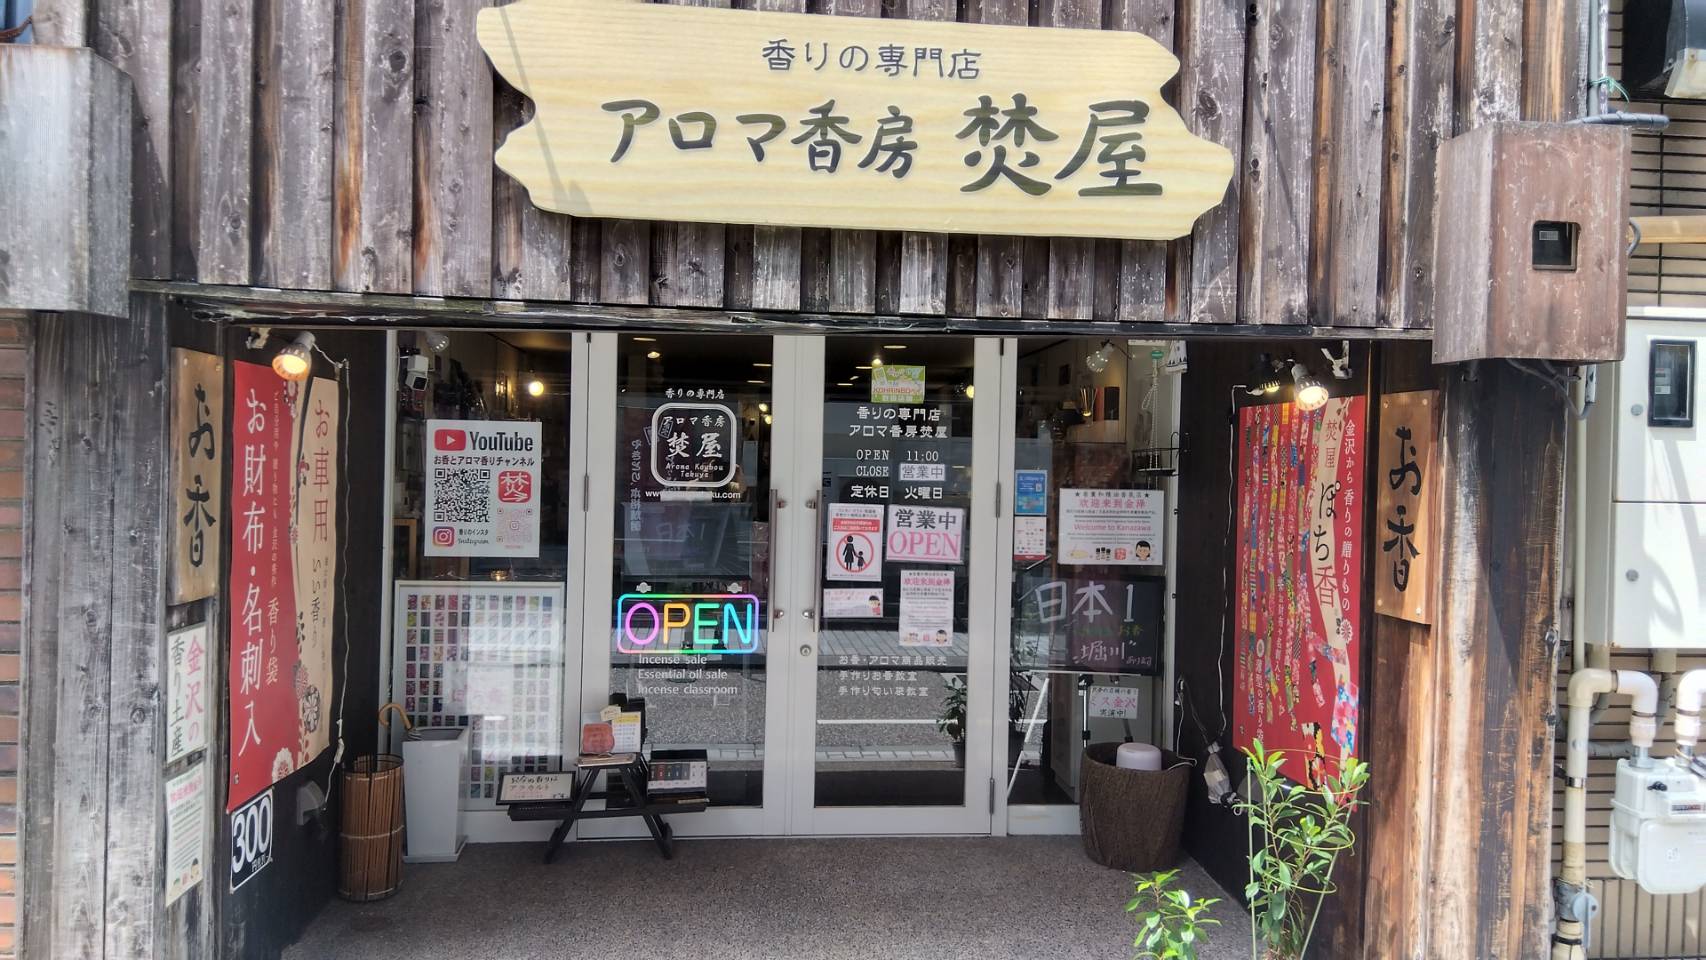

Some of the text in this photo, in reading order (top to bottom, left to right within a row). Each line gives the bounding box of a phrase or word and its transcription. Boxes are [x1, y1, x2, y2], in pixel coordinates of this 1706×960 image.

[761, 39, 982, 80] 香りの専門店
[601, 93, 1164, 197] アロマ香房 焚屋
[665, 387, 725, 400] 香りの専門店
[662, 415, 726, 428] アロマ香房
[856, 406, 942, 422] 香りの専門店
[469, 431, 534, 451] YouTube
[666, 431, 723, 459] 焚屋
[433, 455, 535, 467] お香とアロマ香りチャンネル
[856, 449, 939, 462] OPEN 11:00
[183, 383, 217, 568] お香
[855, 465, 890, 477] CLOSE
[901, 464, 944, 479] 営業中
[850, 485, 943, 500] 定休日 火曜日
[1383, 426, 1422, 592] お香
[895, 508, 957, 530] 営業中
[888, 530, 961, 557] OPEN
[625, 602, 753, 645] OPEN
[638, 654, 708, 664] Incense sale
[638, 668, 728, 680] Essential oil sale
[839, 670, 918, 681] 手作りお香教室
[185, 635, 205, 743] 金沢の
[638, 684, 738, 695] Incense classroom
[232, 796, 271, 873] 300
